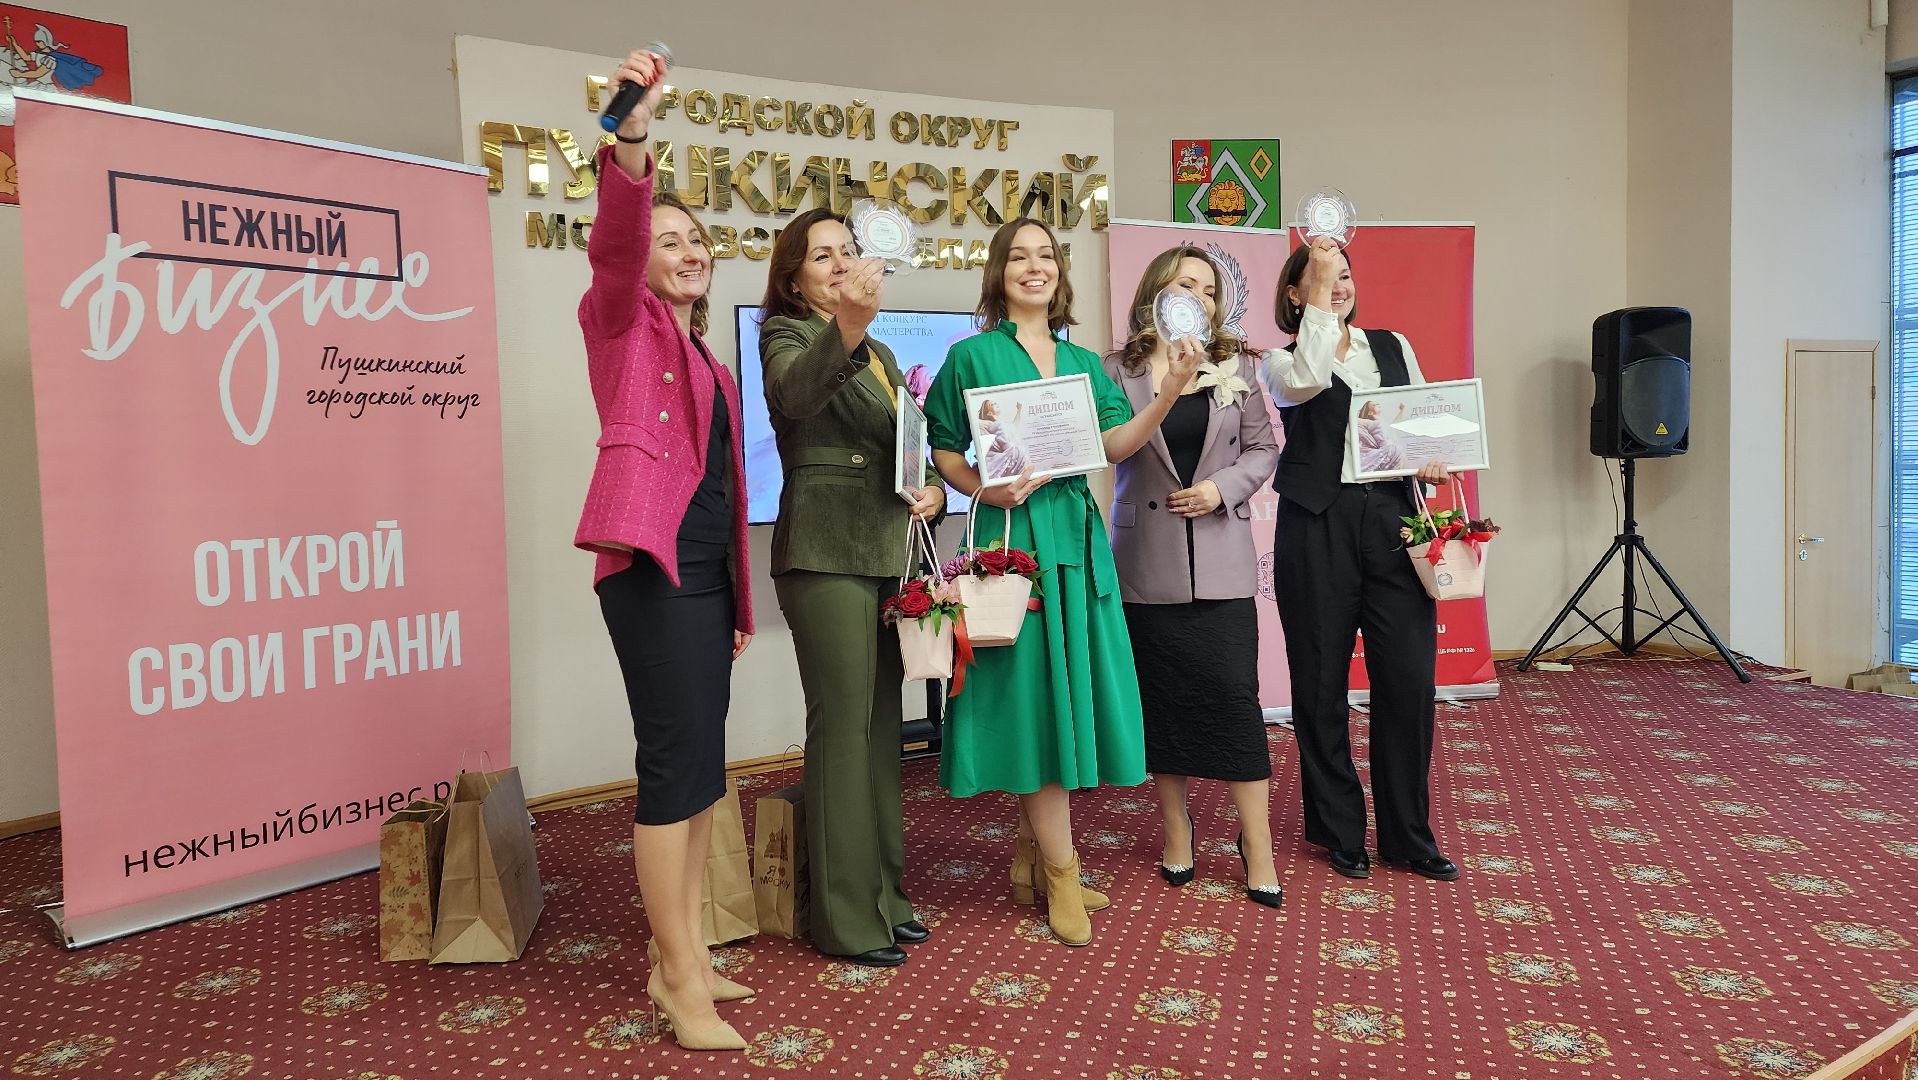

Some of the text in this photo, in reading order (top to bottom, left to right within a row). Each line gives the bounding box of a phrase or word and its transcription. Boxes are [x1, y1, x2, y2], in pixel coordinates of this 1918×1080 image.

[586, 74, 1020, 151] ГРОДСКОЙ ОКРУГ
[181, 200, 348, 258] НЕЖНЫЙ
[872, 327, 934, 337] МАСТЕРСТВА
[882, 314, 929, 324] КОНКУРС
[60, 232, 475, 446] Бизнес
[320, 346, 466, 385] Пушкинский
[306, 384, 481, 419] городской округ
[1028, 400, 1075, 416] ДИПЛОМ
[1411, 403, 1462, 417] ДИПЛОМ
[193, 520, 405, 607] ОТКРОЙ
[127, 610, 463, 717] СВОИ ГРАНИ
